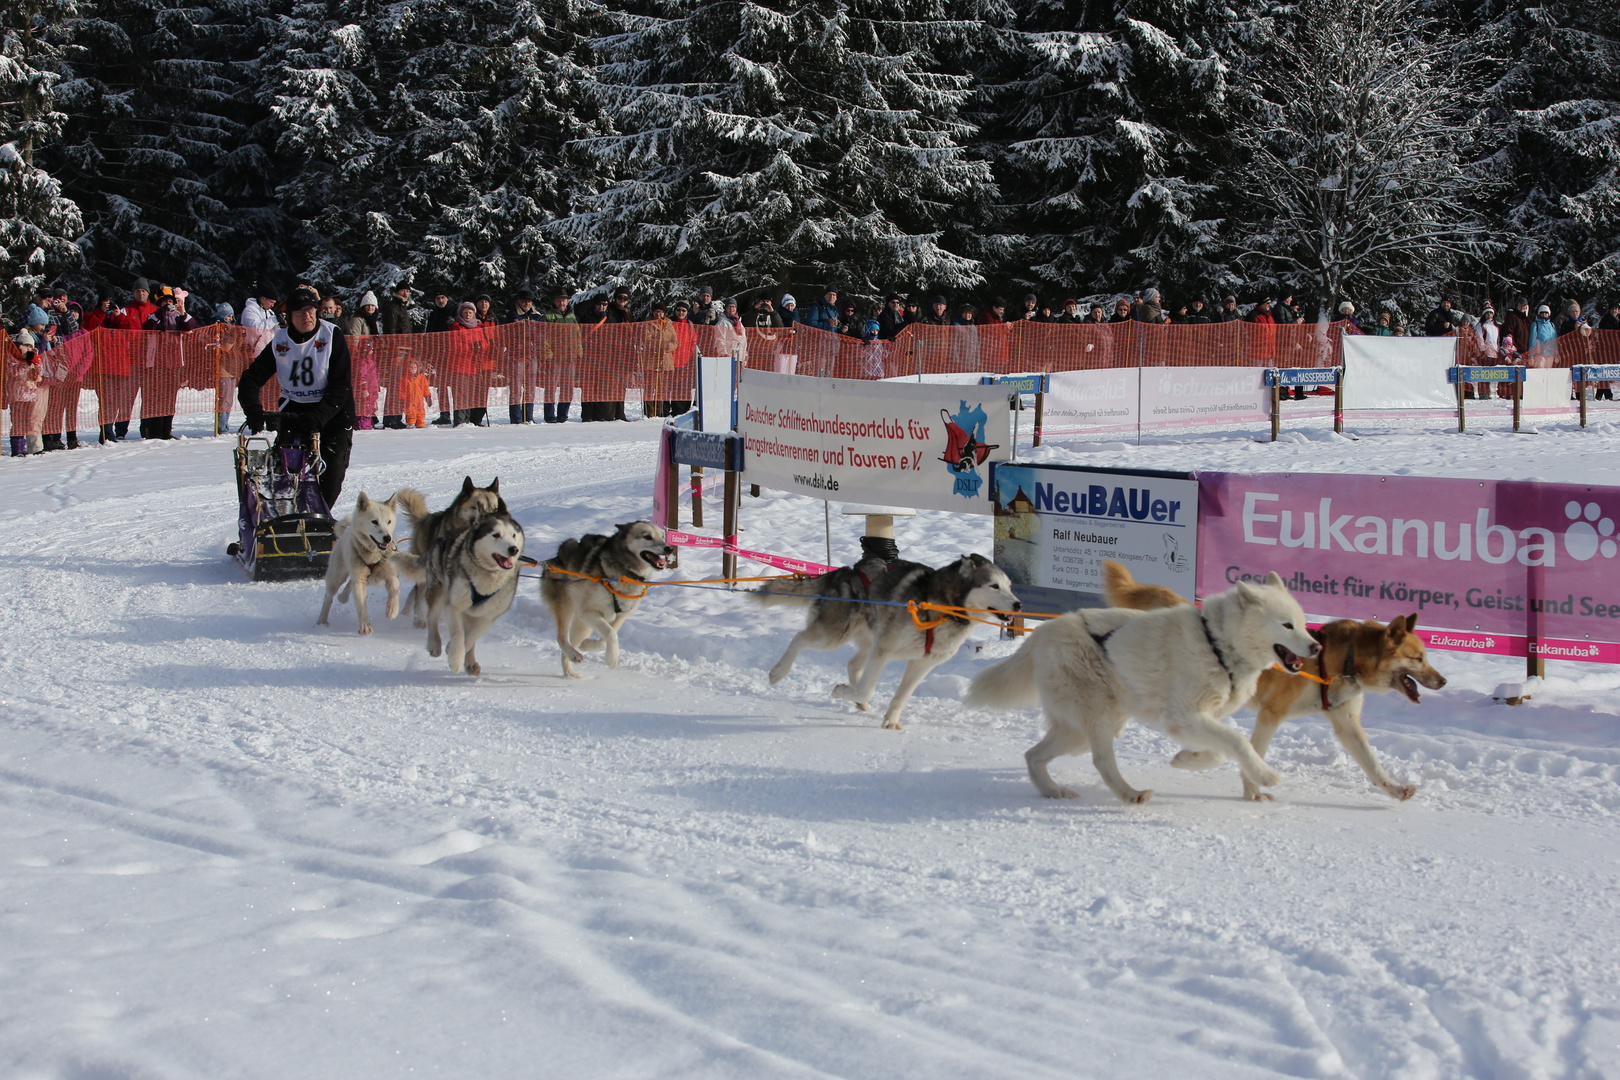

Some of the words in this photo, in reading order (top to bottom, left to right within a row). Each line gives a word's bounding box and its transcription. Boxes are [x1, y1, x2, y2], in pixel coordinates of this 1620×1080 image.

[289, 356, 314, 387] 48
[1297, 372, 1335, 383] MASSERBERG
[745, 402, 777, 426] Deutscher
[778, 408, 904, 441] Schlittenhundesportclub
[908, 419, 930, 440] für
[745, 431, 819, 463] Langstreckenrennen
[823, 445, 844, 466] und
[847, 447, 896, 469] Touren
[793, 472, 839, 491] www.dslt.de
[956, 478, 979, 492] DSLT
[1034, 481, 1181, 523] NeuBAUer
[1053, 528, 1071, 541] Ralf
[1073, 530, 1119, 545] Neubauer
[1242, 491, 1556, 567] Eukanuba
[1083, 548, 1092, 556] 45
[1052, 564, 1064, 573] Funk
[1343, 576, 1374, 598] für
[1379, 580, 1459, 610] Körper,
[1465, 588, 1525, 611] Geist
[1530, 594, 1573, 615] und
[1430, 634, 1485, 649] Eukanuba
[1528, 642, 1589, 657] Eukanuba
